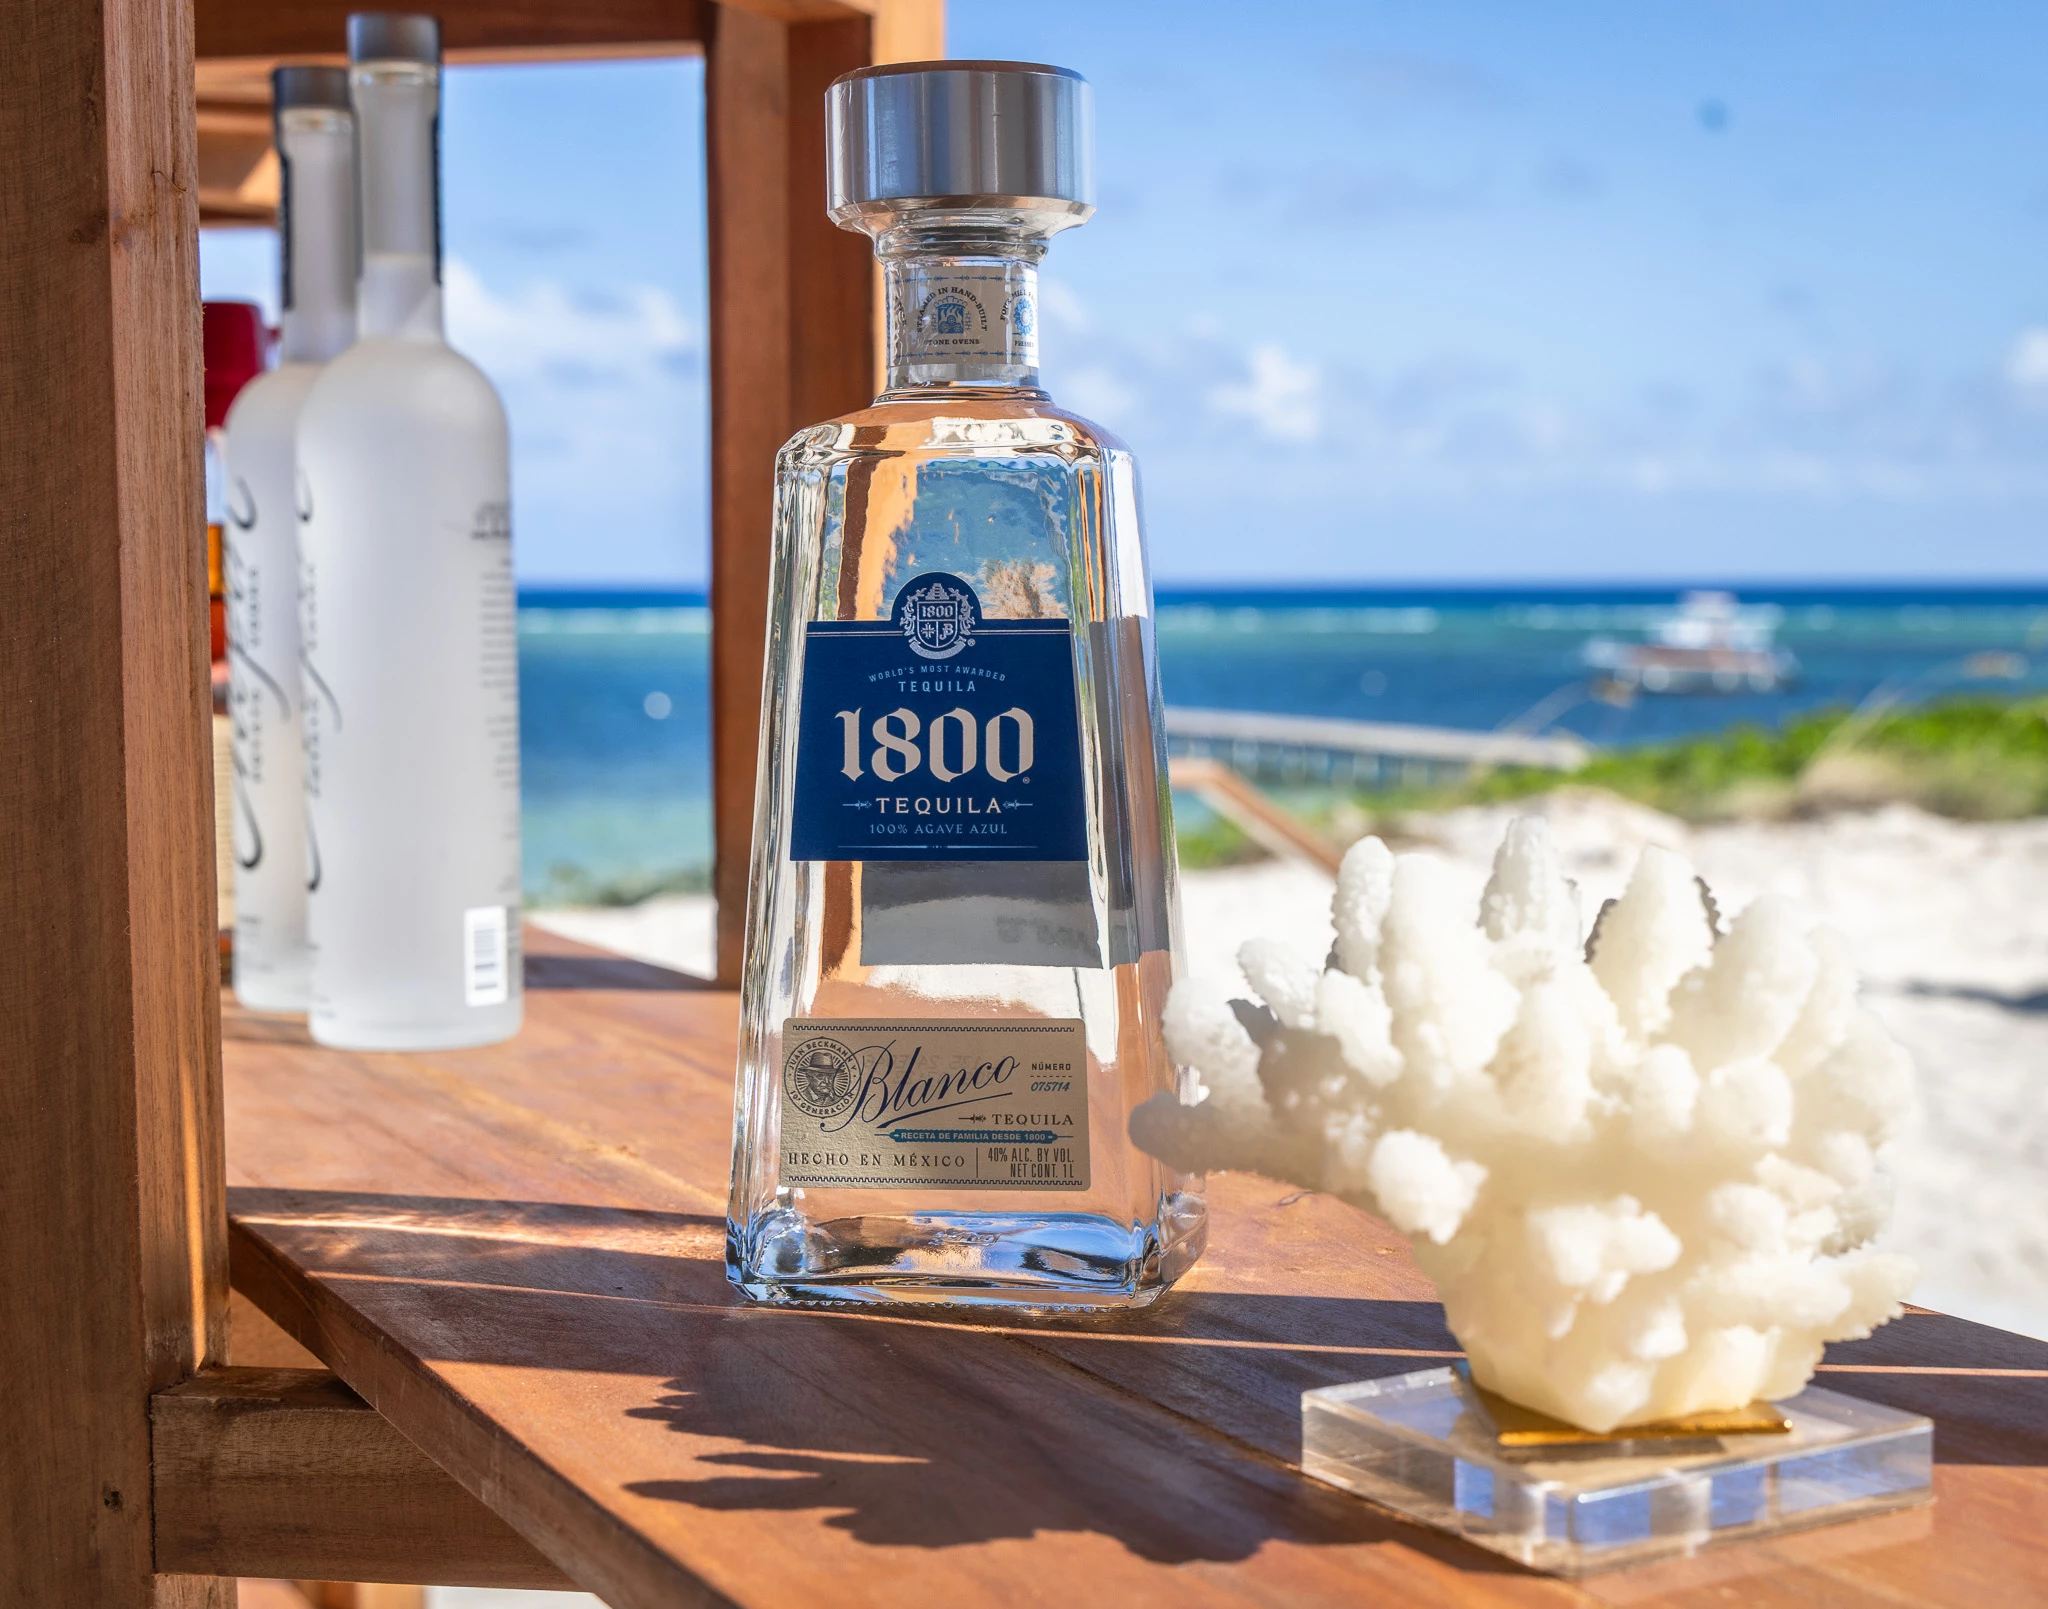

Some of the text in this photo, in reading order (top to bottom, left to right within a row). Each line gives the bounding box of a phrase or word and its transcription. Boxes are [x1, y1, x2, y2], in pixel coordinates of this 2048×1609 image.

[937, 286, 949, 295] IN
[951, 286, 988, 332] HAND-BUILT
[921, 605, 954, 618] 1800
[868, 665, 1007, 683] WORLD'S MOST AWARDED
[898, 680, 976, 693] TEQUILA
[834, 706, 1035, 783] 1800
[876, 797, 1003, 815] TEQUILA
[869, 823, 1008, 835] 100% AGAVE AZUL
[788, 1048, 805, 1071] JUAN
[1031, 1061, 1072, 1071] NÚMERO
[820, 1039, 1021, 1133] Blanco
[1030, 1080, 1071, 1093] 075714
[992, 1113, 1074, 1126] TEQUILA
[901, 1132, 1046, 1141] RECETA DE FAMILIA DESDE 1800
[788, 1151, 965, 1167] HECHO EN MÉXICO
[988, 1147, 1075, 1162] 40% ALC. BY VOL.
[1010, 1163, 1075, 1178] NET CONT. 1L
